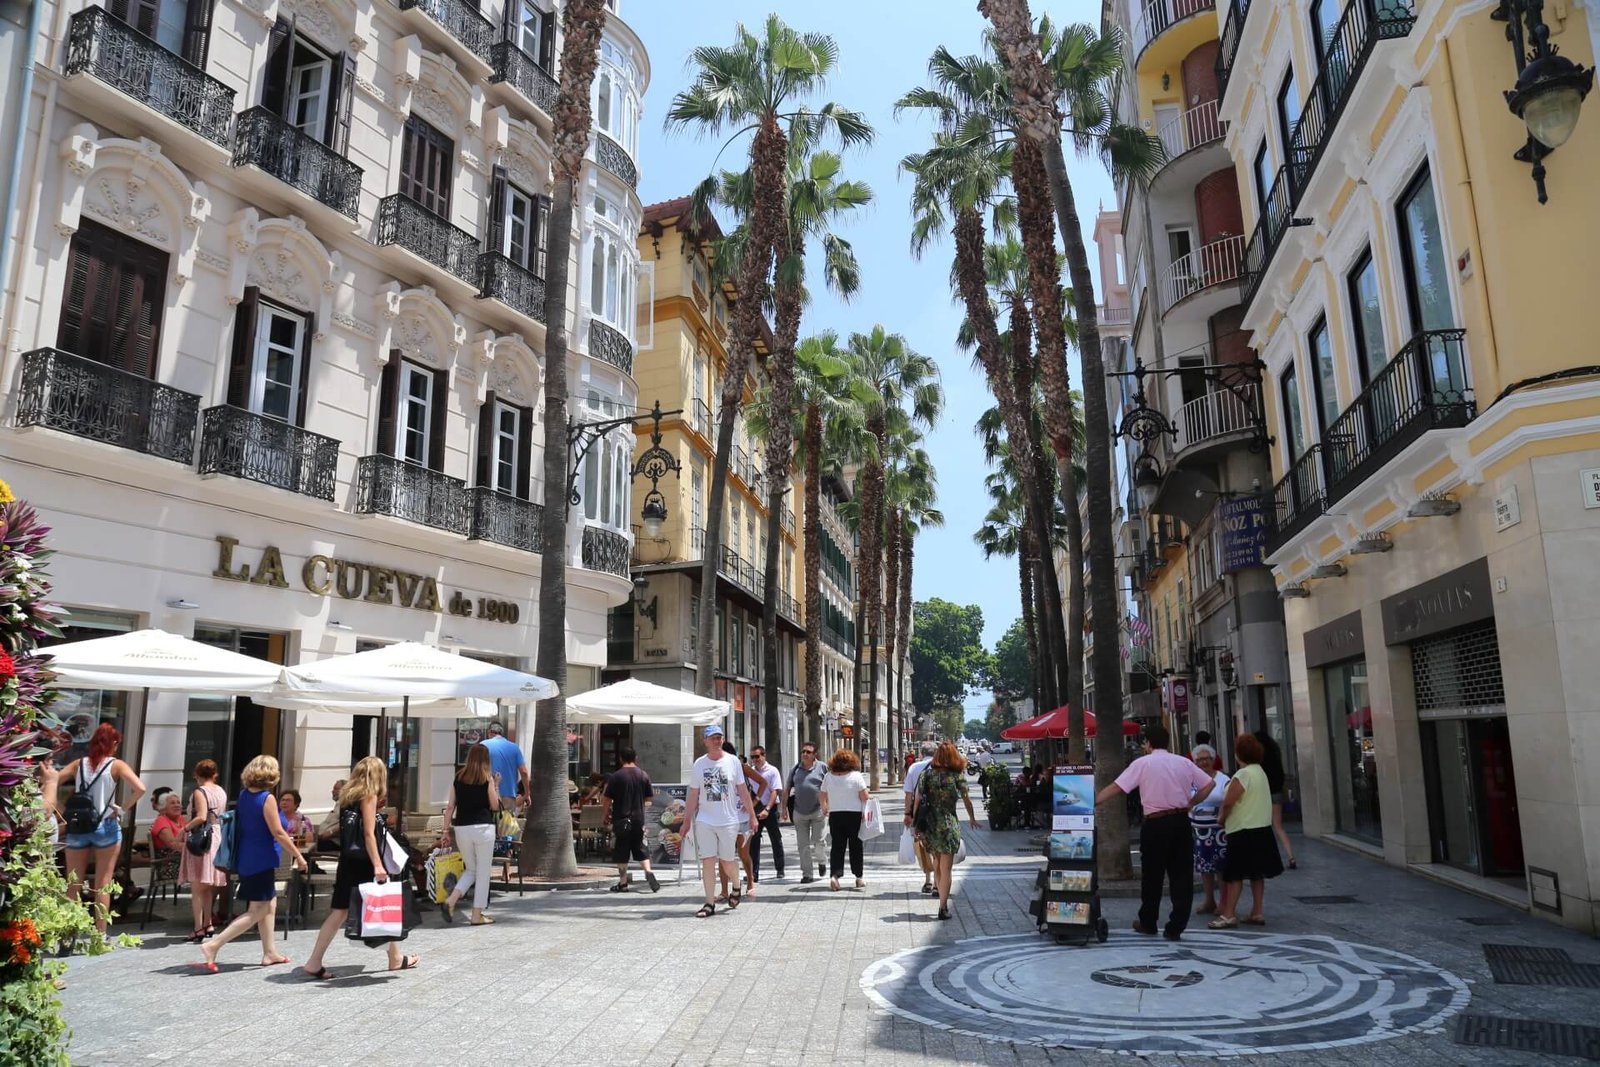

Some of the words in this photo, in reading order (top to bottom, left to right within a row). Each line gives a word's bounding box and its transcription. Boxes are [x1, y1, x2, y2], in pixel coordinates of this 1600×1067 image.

[213, 536, 290, 588] LA
[301, 554, 444, 613] CUEVA
[449, 591, 473, 617] de
[476, 598, 520, 625] 1900
